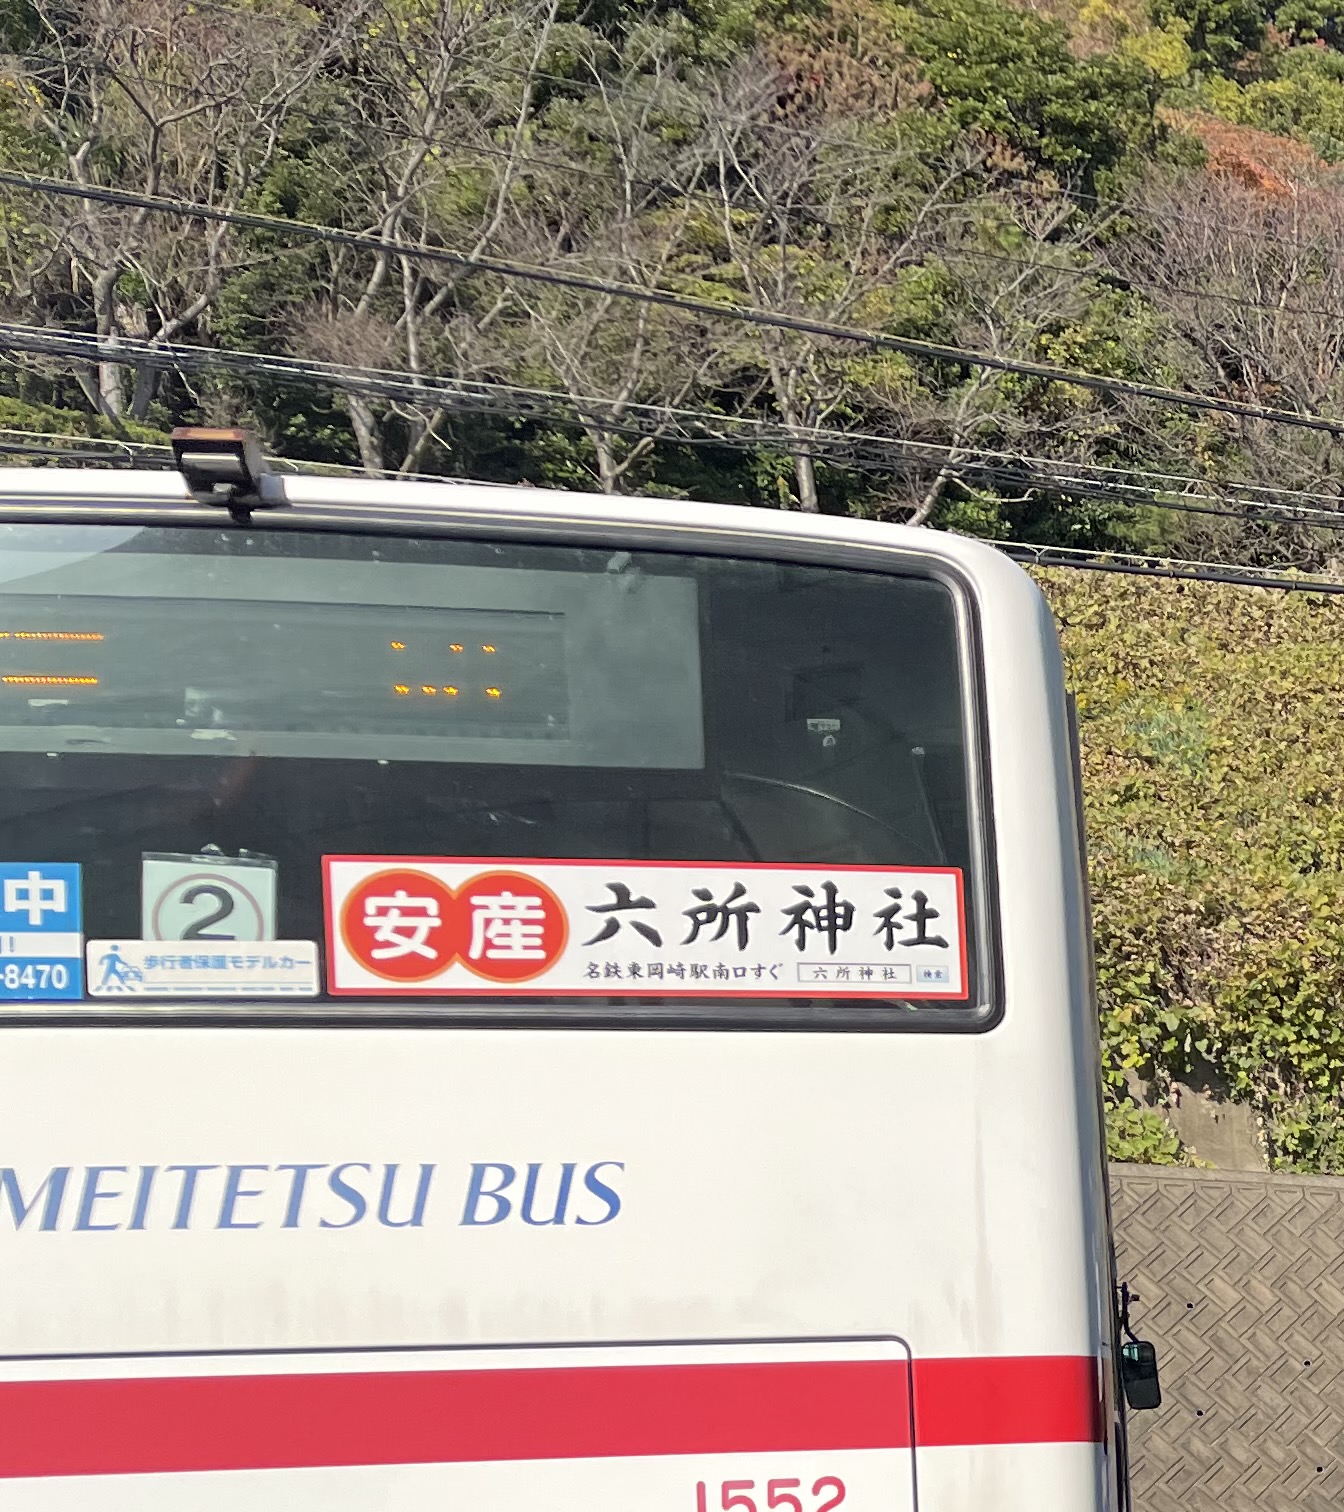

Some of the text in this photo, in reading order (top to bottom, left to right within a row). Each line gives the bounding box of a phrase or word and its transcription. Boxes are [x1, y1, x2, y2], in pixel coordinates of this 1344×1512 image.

[3, 870, 67, 926] 中
[364, 879, 951, 960] 安産 六所神社
[583, 960, 784, 981] 名鉄東岡崎駅南口すぐ
[812, 965, 898, 981] 六所神社
[0, 1161, 626, 1232] MEITETSU BUS
